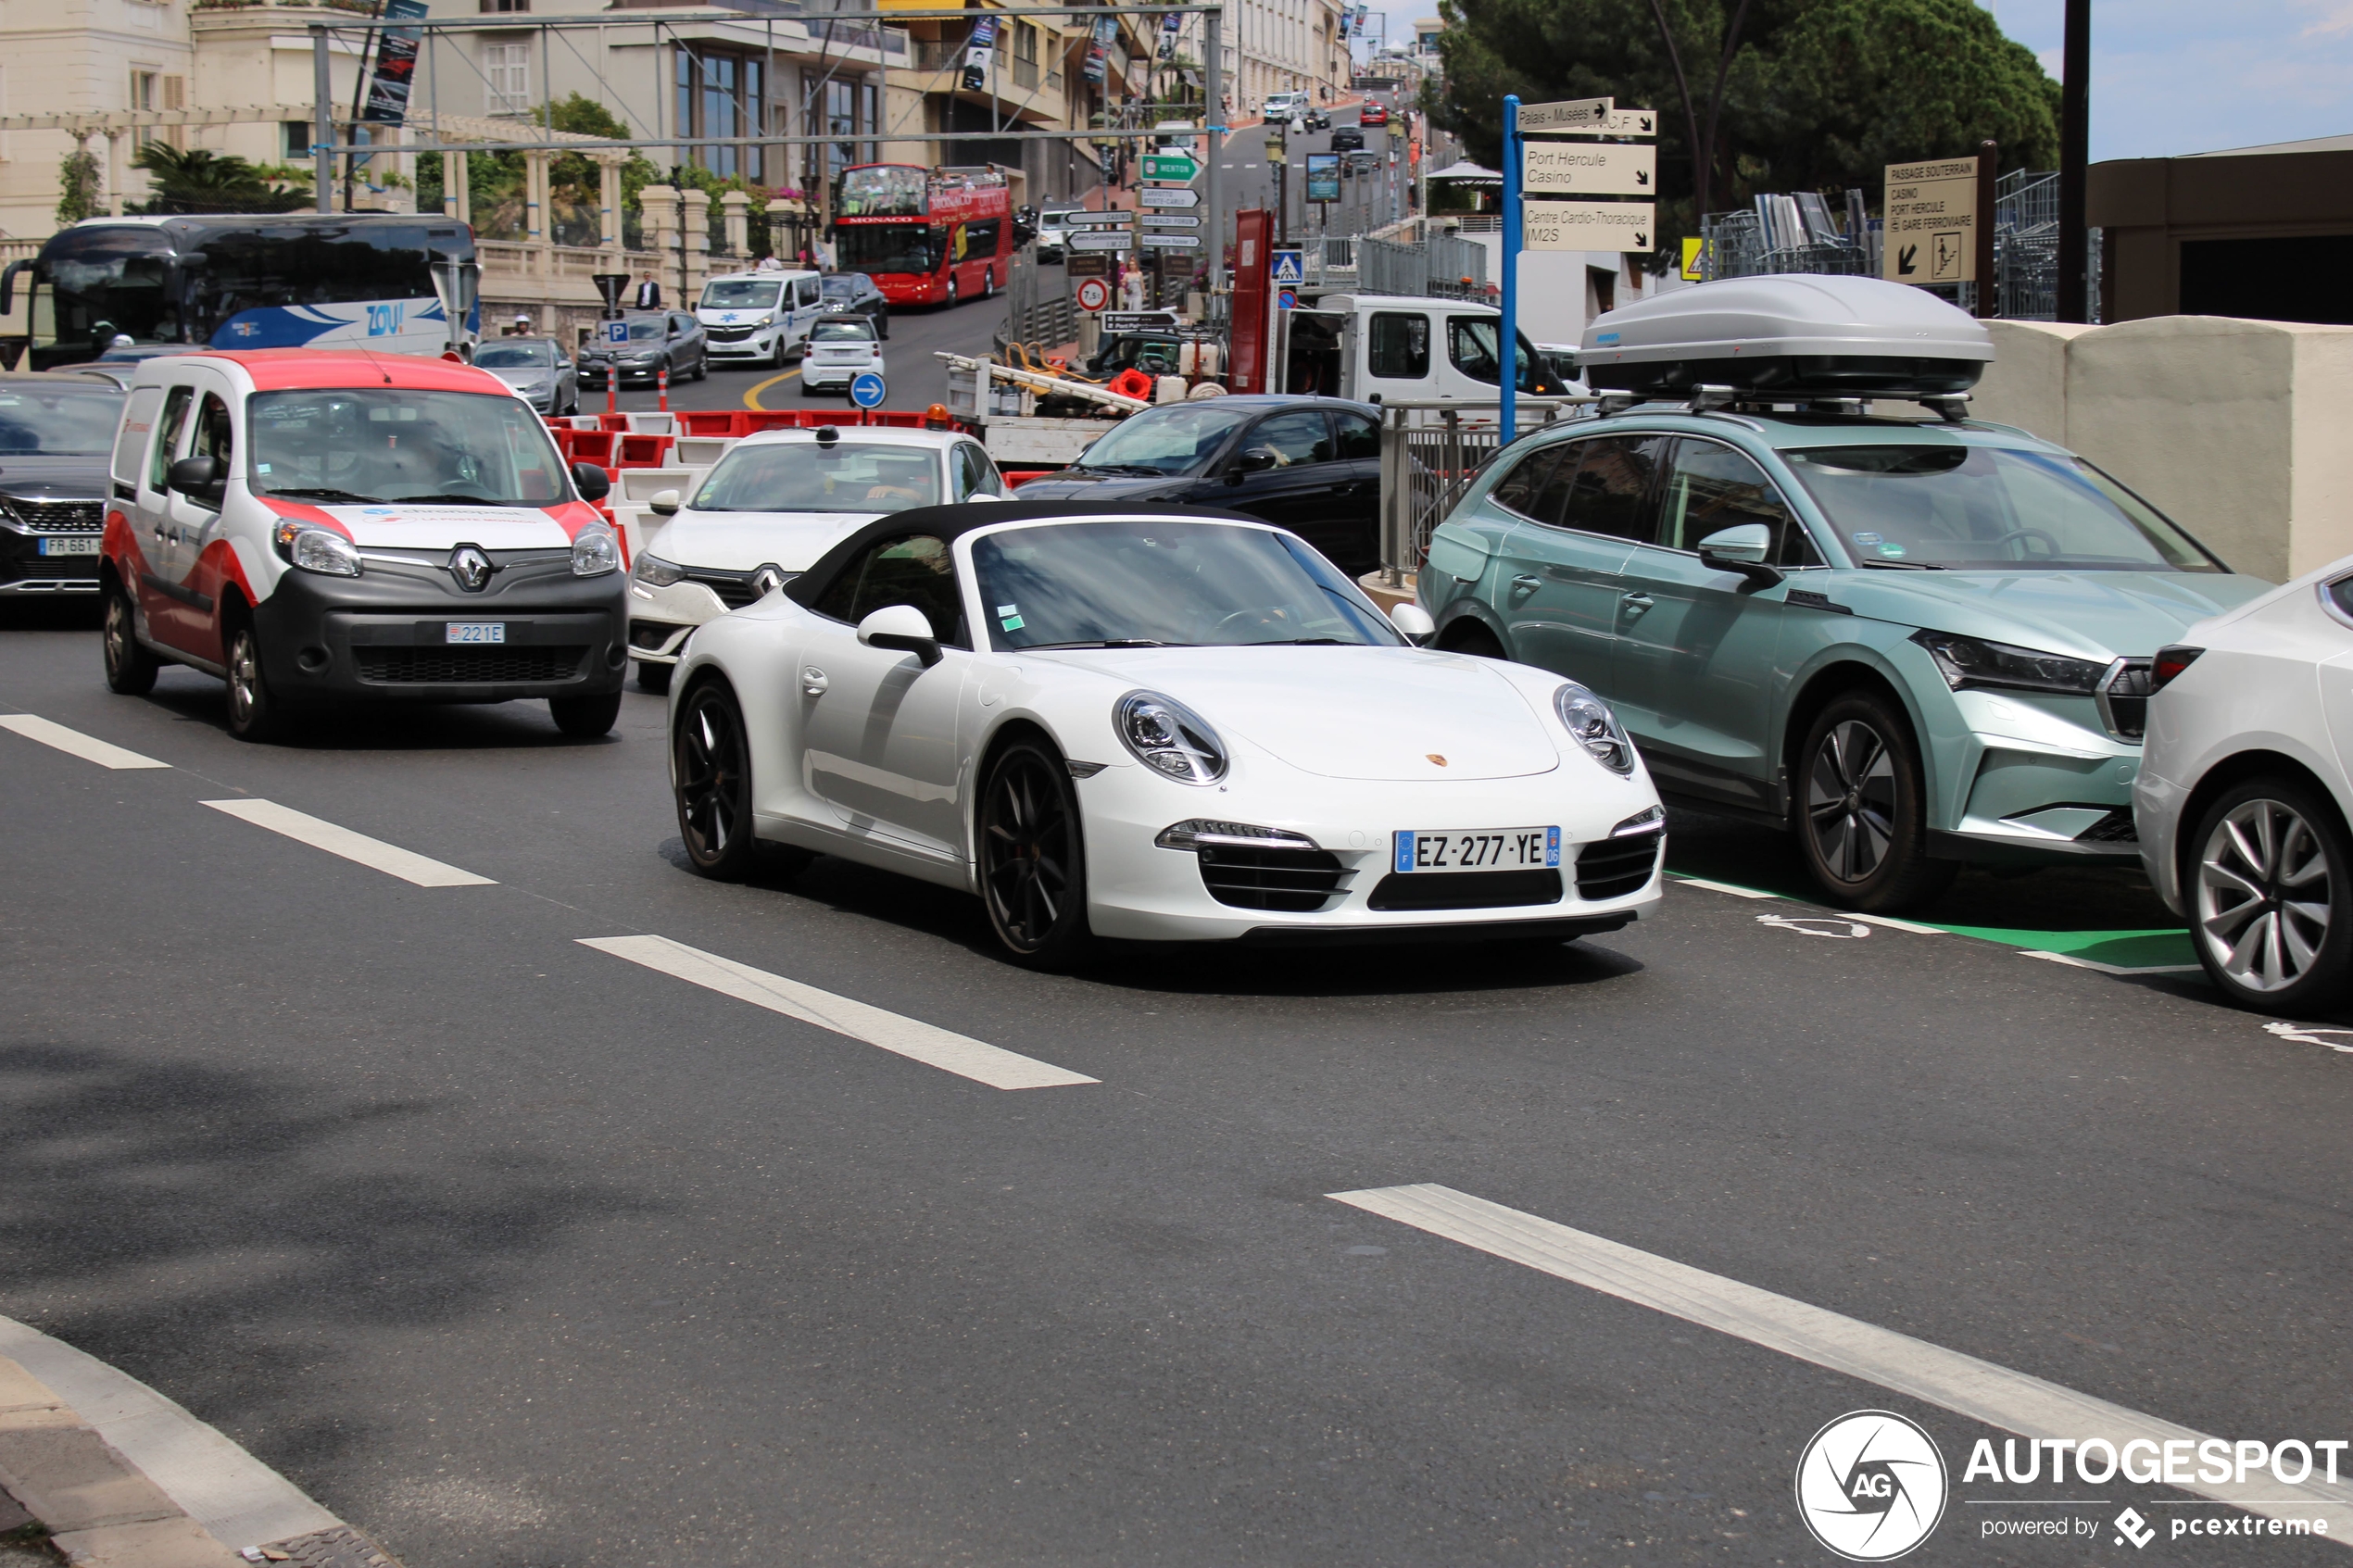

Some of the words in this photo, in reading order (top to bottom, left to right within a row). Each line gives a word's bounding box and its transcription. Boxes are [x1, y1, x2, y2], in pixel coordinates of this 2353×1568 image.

[1518, 110, 1545, 125] Palais
[1554, 107, 1589, 122] Musées
[1527, 151, 1554, 165] Port
[1557, 152, 1606, 167] Hercule
[1160, 164, 1189, 173] MENTON
[1527, 169, 1572, 183] Casino
[1891, 167, 1924, 181] PASSAGE
[1926, 162, 1972, 178] SOUTERRAIN
[1891, 188, 1918, 200] CASINO
[930, 194, 972, 210] MONACO
[1891, 204, 1909, 216] PORT
[1911, 201, 1944, 214] HERCULE
[1526, 210, 1558, 224] Centre
[1560, 210, 1647, 228] Cardio-Thoracique
[1902, 219, 1922, 231] GARE
[1923, 215, 1971, 230] FERROVIAIRE
[1526, 228, 1560, 242] IM2S
[366, 302, 404, 336] ZOU!
[612, 325, 624, 340] P
[402, 508, 525, 517] chronopost
[462, 626, 501, 641] 221E
[1416, 834, 1541, 867] EZ-277-YE
[1547, 848, 1559, 862] 06
[1402, 854, 1408, 863] F
